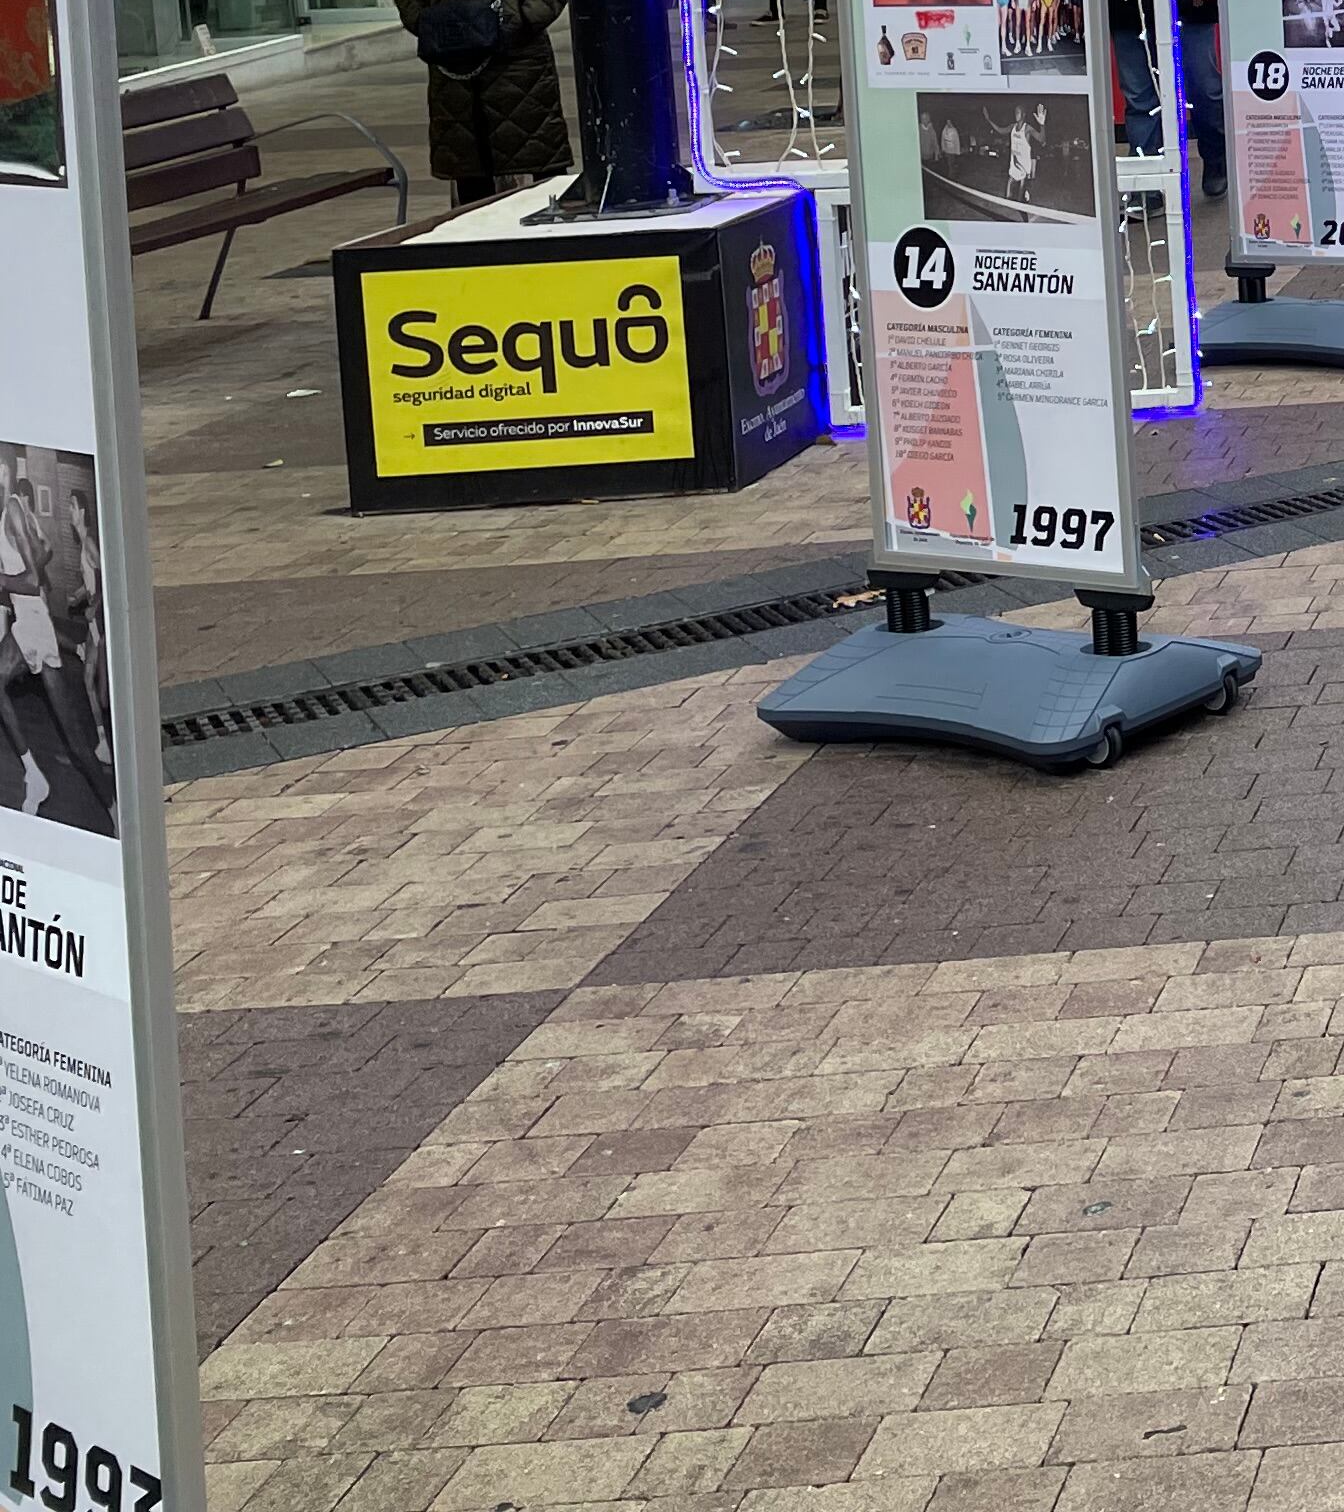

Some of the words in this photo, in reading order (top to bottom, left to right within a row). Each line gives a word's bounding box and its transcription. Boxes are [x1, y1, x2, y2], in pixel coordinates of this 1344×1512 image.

[1252, 62, 1286, 90] 18
[1301, 76, 1328, 89] SAN
[1303, 66, 1331, 75] NOCHE
[1333, 66, 1344, 76] DE
[902, 246, 947, 289] 14
[975, 255, 1018, 270] NOCHE
[1020, 257, 1037, 271] DE
[973, 272, 1012, 293] SAN
[1013, 269, 1073, 295] ANTÓN
[387, 284, 669, 394] Sequô
[887, 323, 926, 332] CATEGORÍA
[928, 324, 969, 334] MASCULINA
[993, 327, 1033, 338] CATEGORÍA
[1035, 329, 1073, 339] FEMENINA
[393, 384, 475, 406] seguridad
[479, 381, 531, 402] digital
[433, 422, 487, 441] Servicio
[489, 420, 545, 438] ofrecido
[547, 422, 570, 437] por
[573, 415, 644, 432] InnovaSur
[1010, 504, 1115, 552] 1997
[54, 1051, 112, 1088] FEMENINA
[43, 1079, 101, 1113] ROMANOVA
[8, 1091, 46, 1118] JOSEFA
[47, 1106, 75, 1132] CRUZ
[11, 1119, 50, 1150] ESTHER
[52, 1137, 100, 1171] PEDROSA
[14, 1149, 45, 1176] ELENA
[47, 1163, 83, 1192] COBOS
[55, 1194, 74, 1217] PAZ
